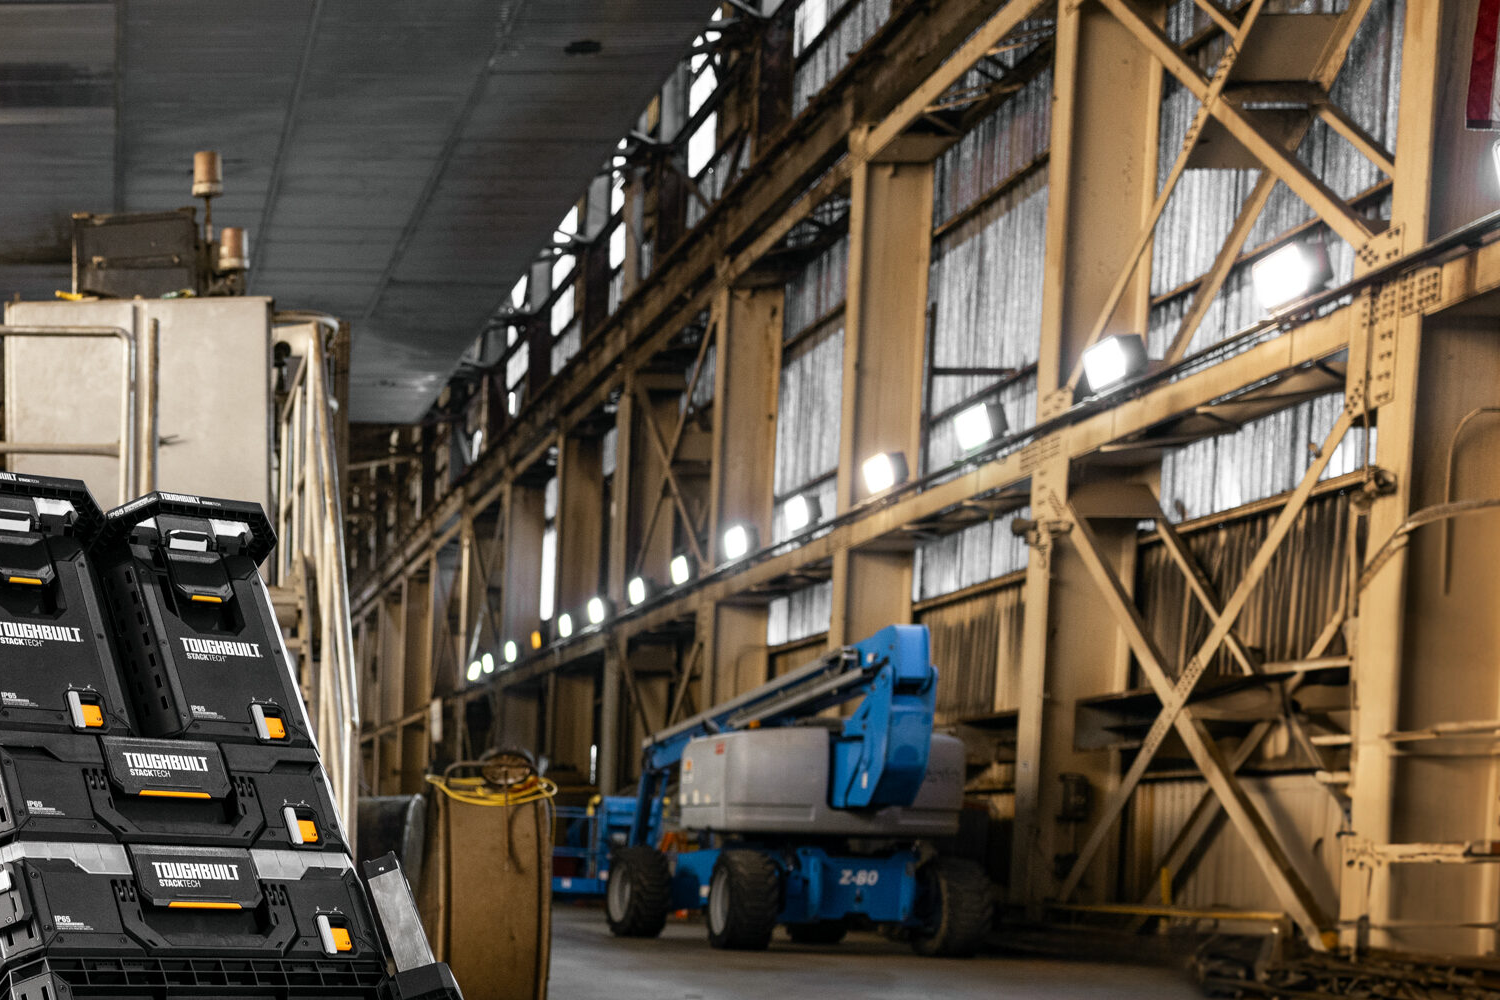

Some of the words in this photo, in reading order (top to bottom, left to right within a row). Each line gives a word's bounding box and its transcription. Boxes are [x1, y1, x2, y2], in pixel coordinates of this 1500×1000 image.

[158, 492, 201, 504] TOUGHBUILT
[0, 636, 41, 648] STACKTECH
[180, 637, 260, 658] TOUGHBUILT
[186, 652, 225, 663] STACKTECH
[0, 691, 17, 699] IP65
[190, 704, 206, 712] IP65
[123, 751, 208, 772] TOUGHBUILT
[129, 768, 171, 778] STACKTECH
[26, 799, 43, 808] IP65
[152, 861, 239, 881] TOUGHBUILT
[159, 878, 201, 888] STACKTECH
[54, 915, 71, 923] IP65
